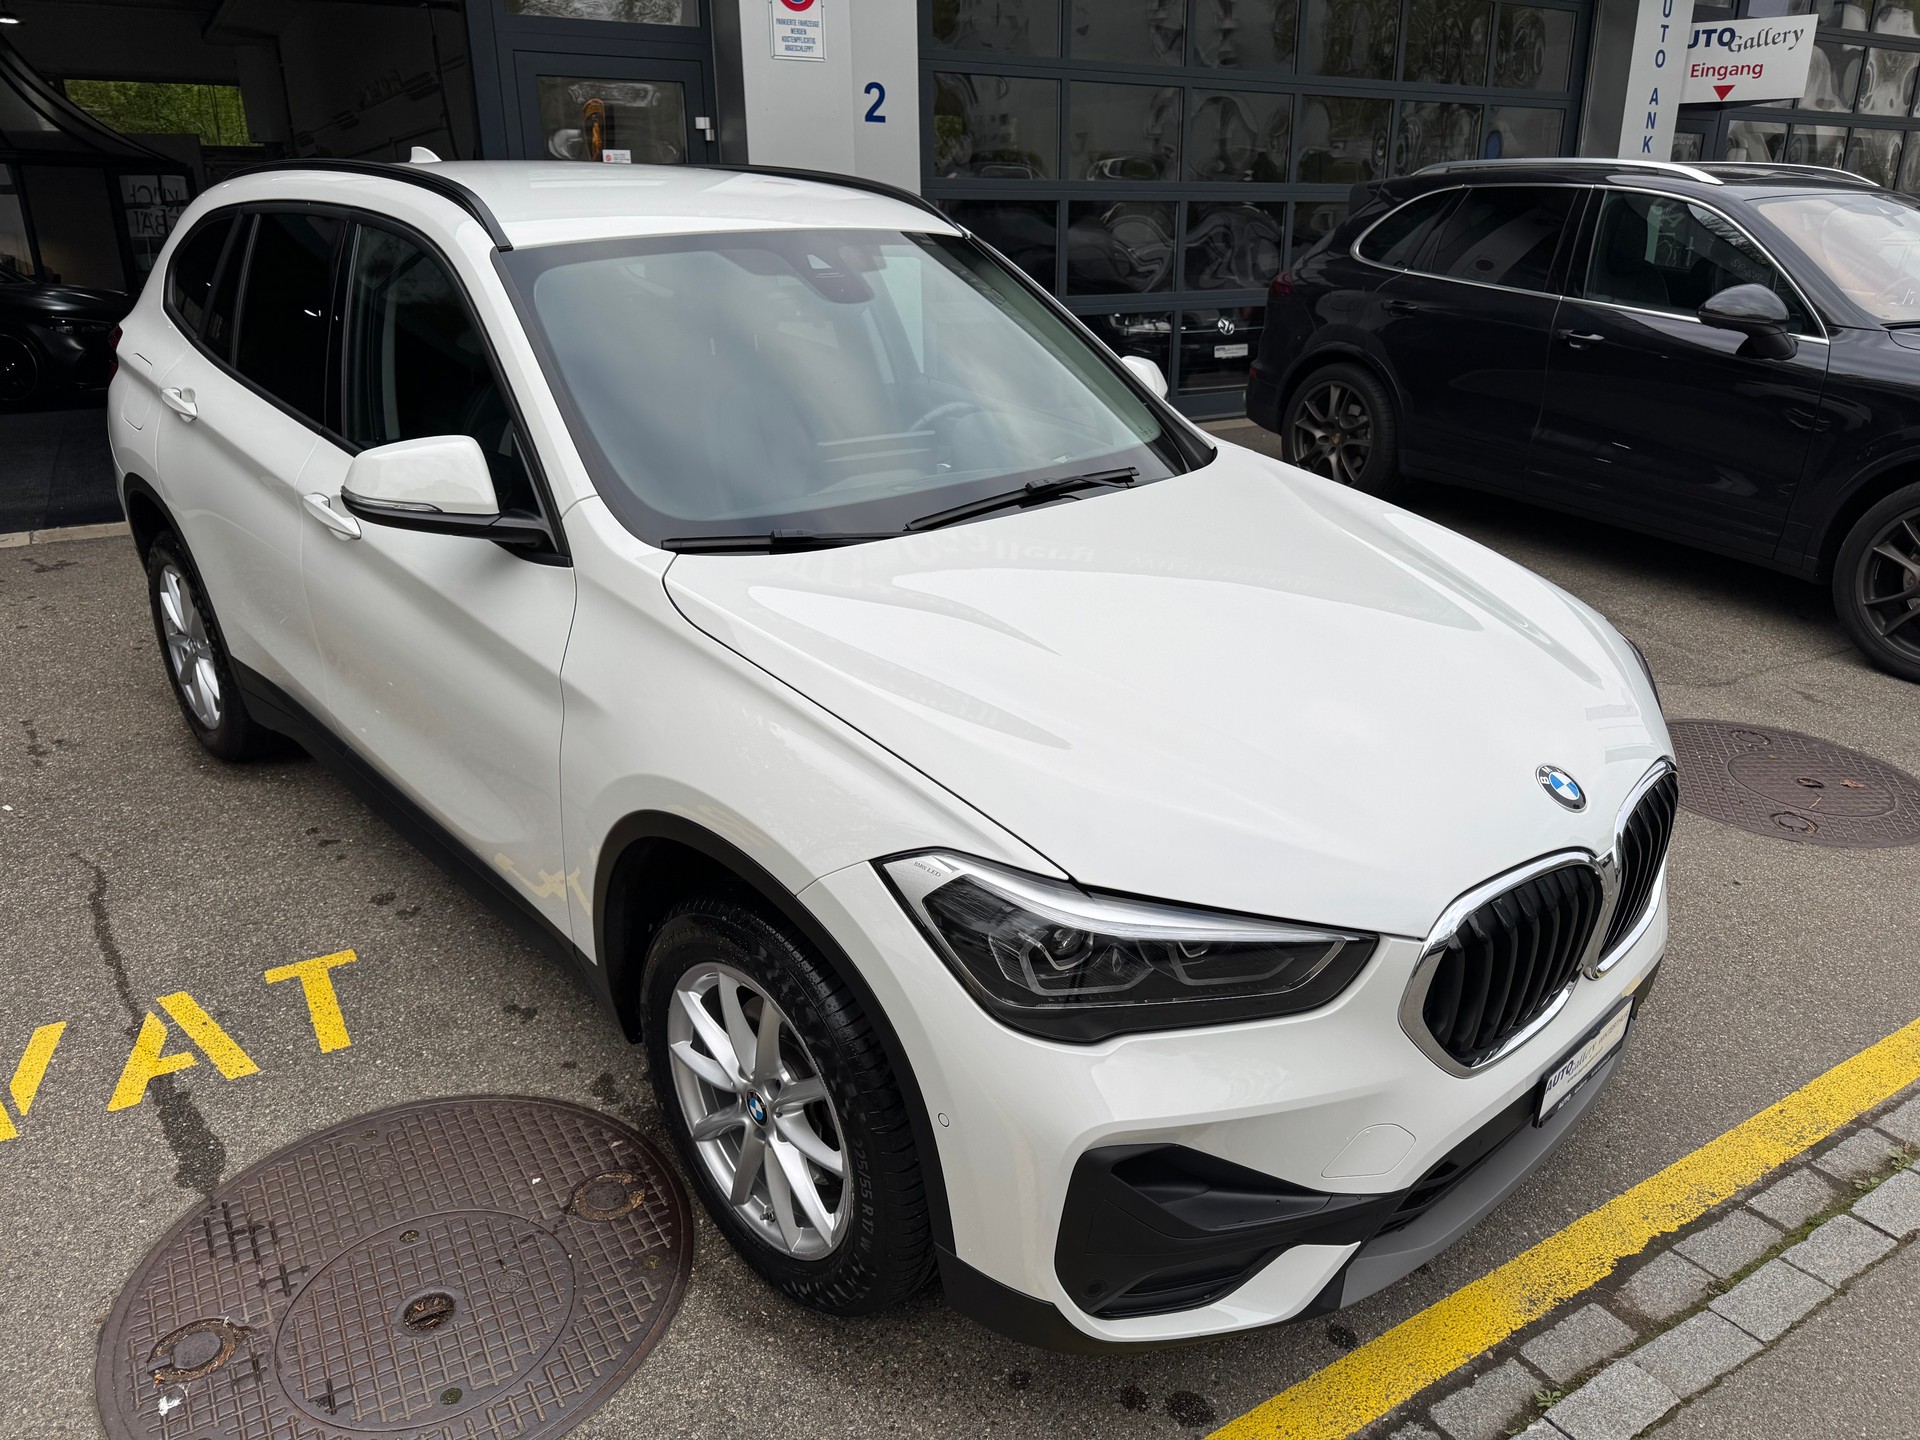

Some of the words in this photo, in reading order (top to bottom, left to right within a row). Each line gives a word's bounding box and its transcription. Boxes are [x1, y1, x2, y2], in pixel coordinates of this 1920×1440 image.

[1690, 63, 1764, 81] Eingang
[863, 81, 886, 123] 2
[927, 867, 940, 877] LED
[0, 949, 357, 1142] VAT
